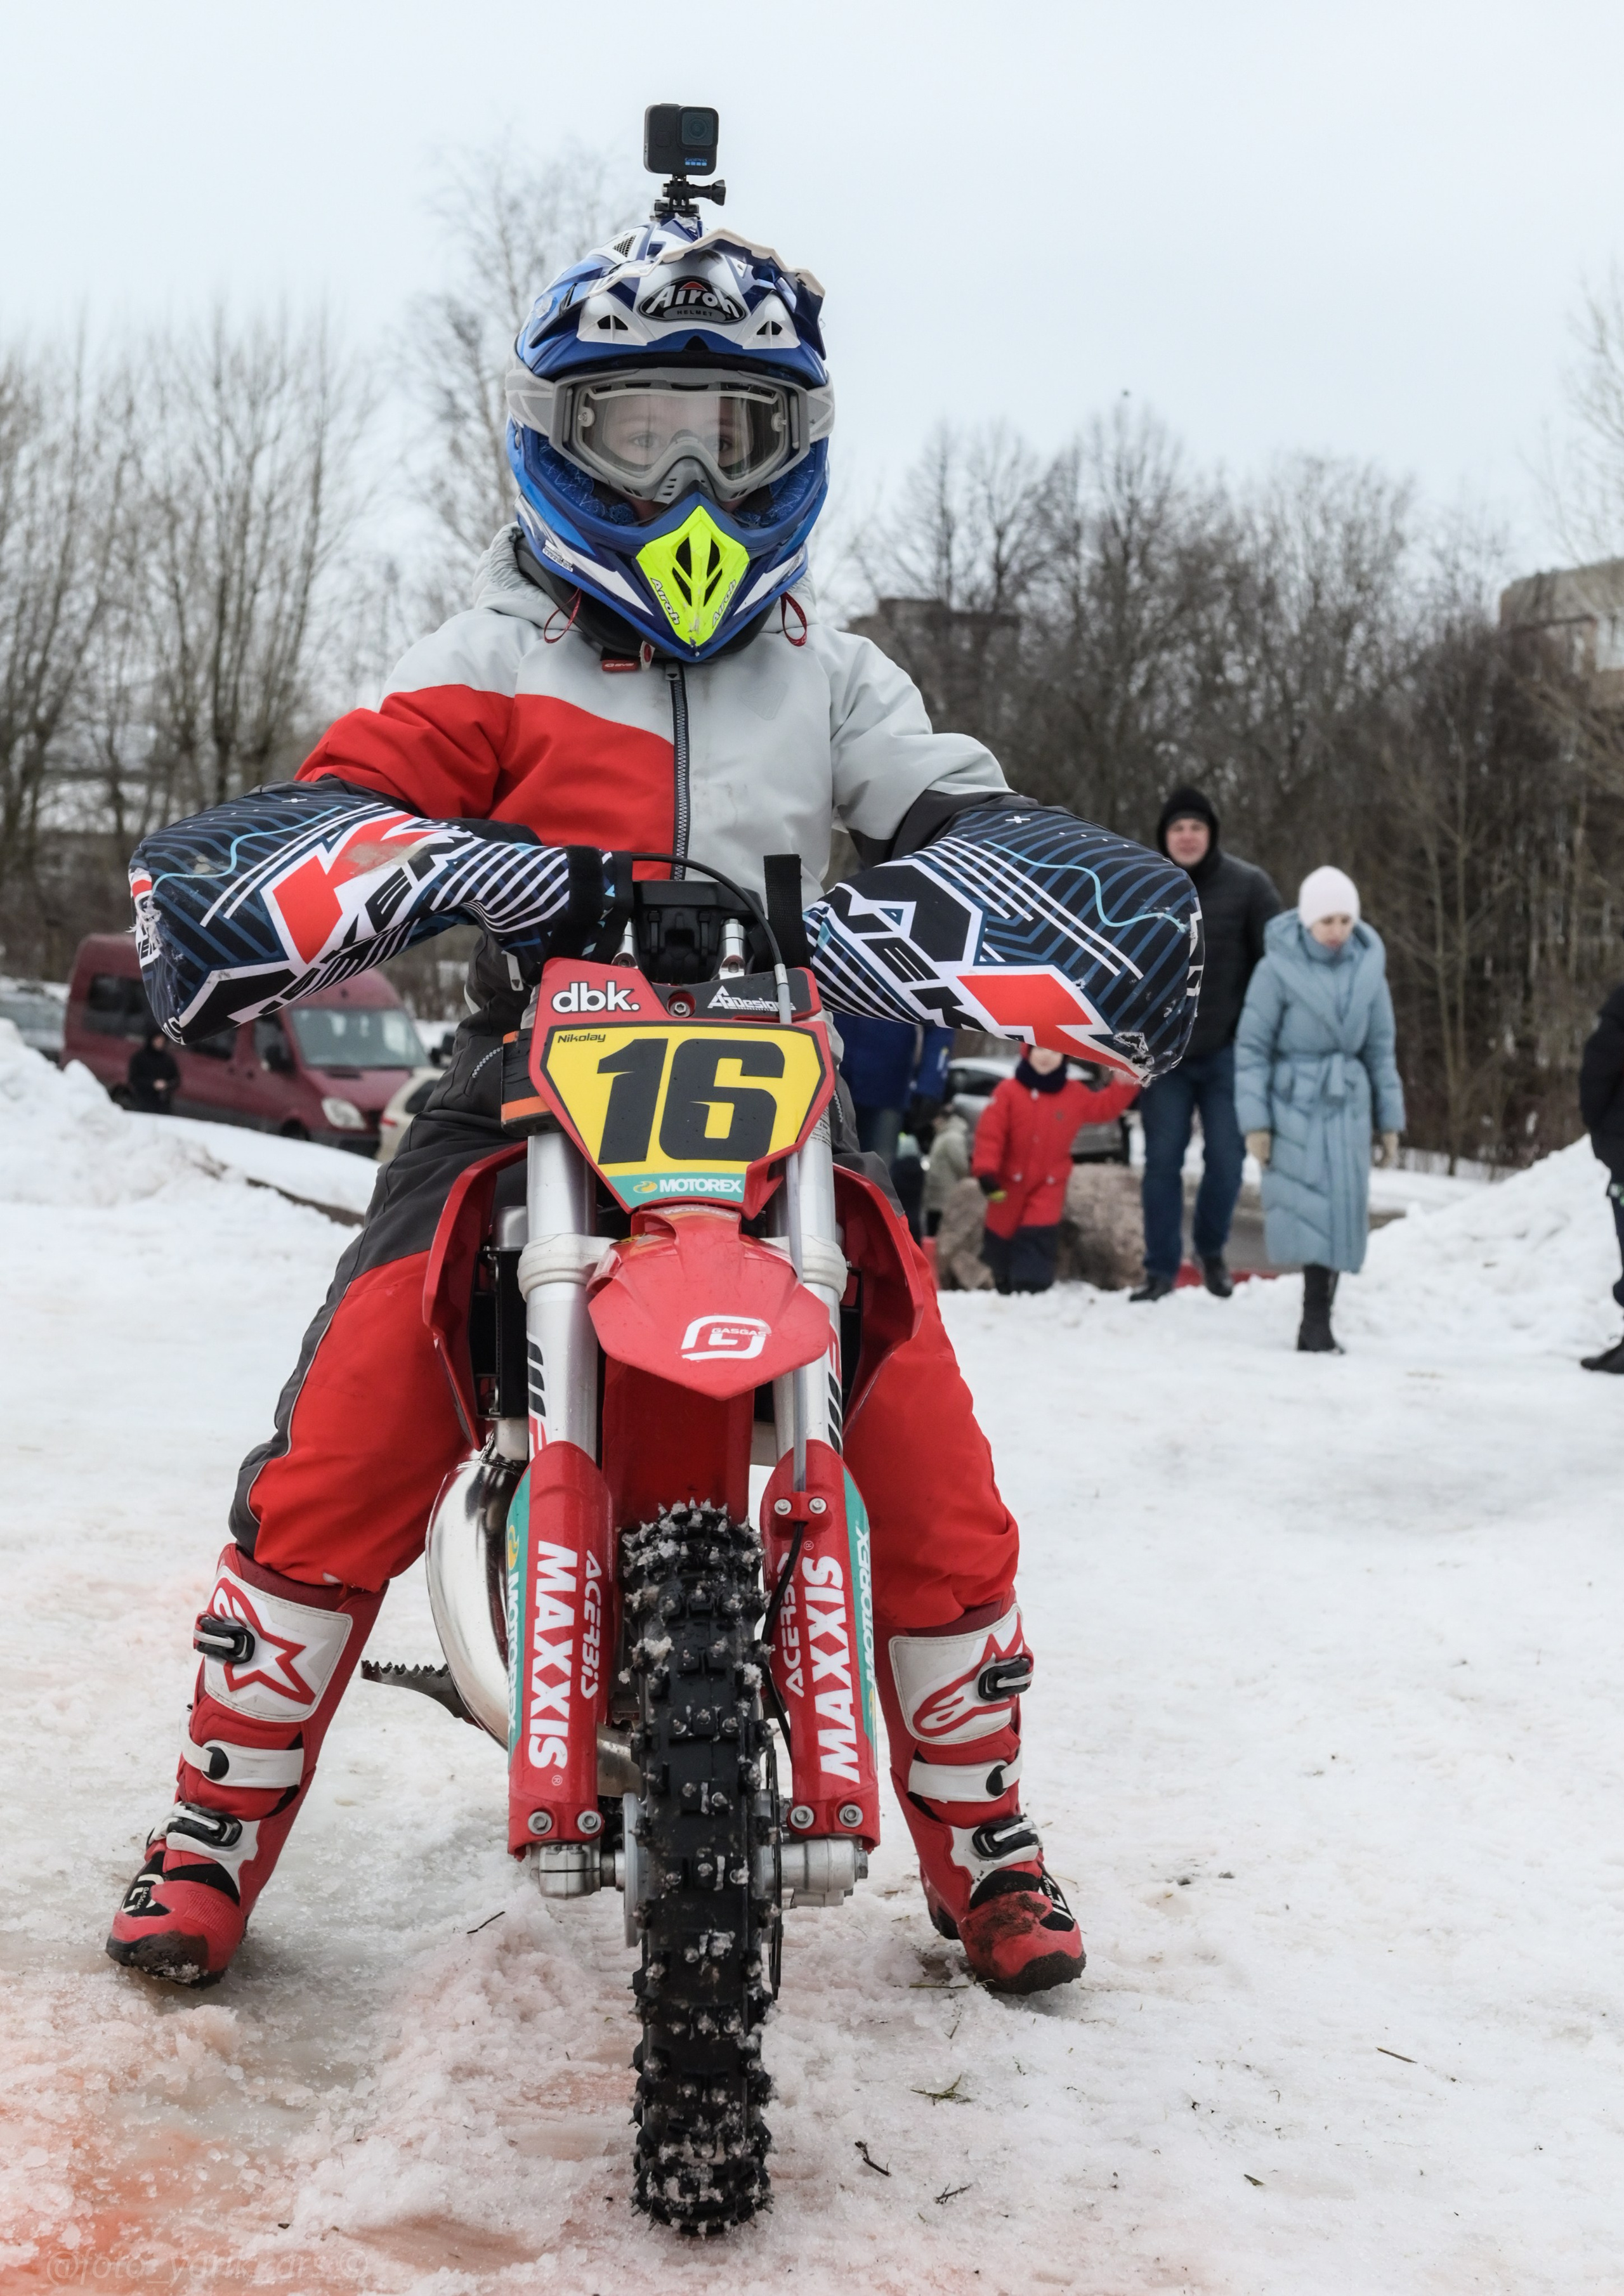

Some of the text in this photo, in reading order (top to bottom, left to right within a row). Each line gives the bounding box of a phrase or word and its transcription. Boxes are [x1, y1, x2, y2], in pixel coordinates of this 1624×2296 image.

[645, 285, 740, 318] Airoh
[650, 578, 680, 625] Airoh
[558, 1033, 606, 1043] Nikolay
[597, 1038, 785, 1165] 16
[660, 1178, 742, 1193] MOTOREX
[712, 1327, 767, 1337] GASGAS
[134, 1887, 149, 1910] GASGAS
